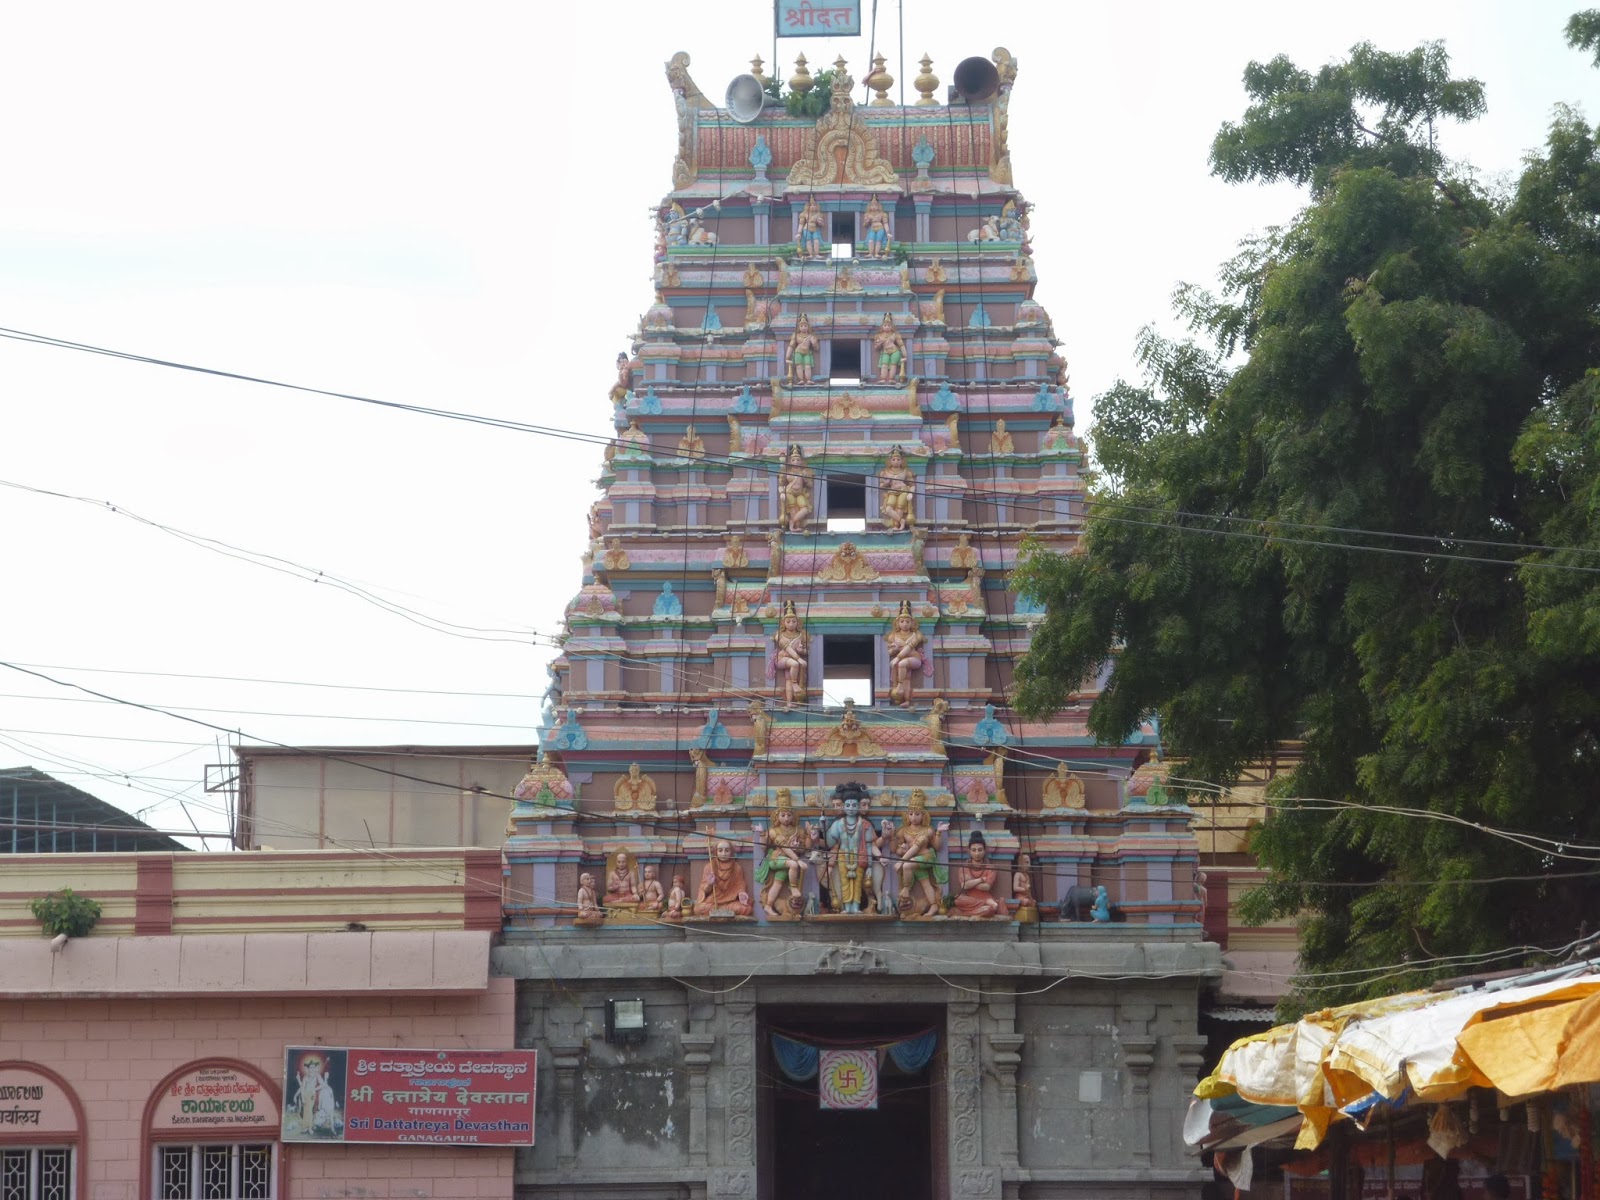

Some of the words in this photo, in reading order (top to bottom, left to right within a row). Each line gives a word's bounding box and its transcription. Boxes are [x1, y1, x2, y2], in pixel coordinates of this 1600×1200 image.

[354, 1058, 377, 1076] ಶ್ರೀ
[379, 1060, 456, 1078] ದತ್ತಾತ್ರೇಯ
[459, 1060, 528, 1080] ದೇವಸ್ಥಾನ
[350, 1086, 374, 1103] श्री
[382, 1087, 449, 1104] दत्तात्रेय
[181, 1097, 255, 1114] ಕಾರ್ಯಾಲಯ
[349, 1117, 370, 1130] Sri
[374, 1118, 449, 1133] Dattatreya
[455, 1119, 530, 1131] Devasthan
[397, 1134, 479, 1143] GANAGAPUR
